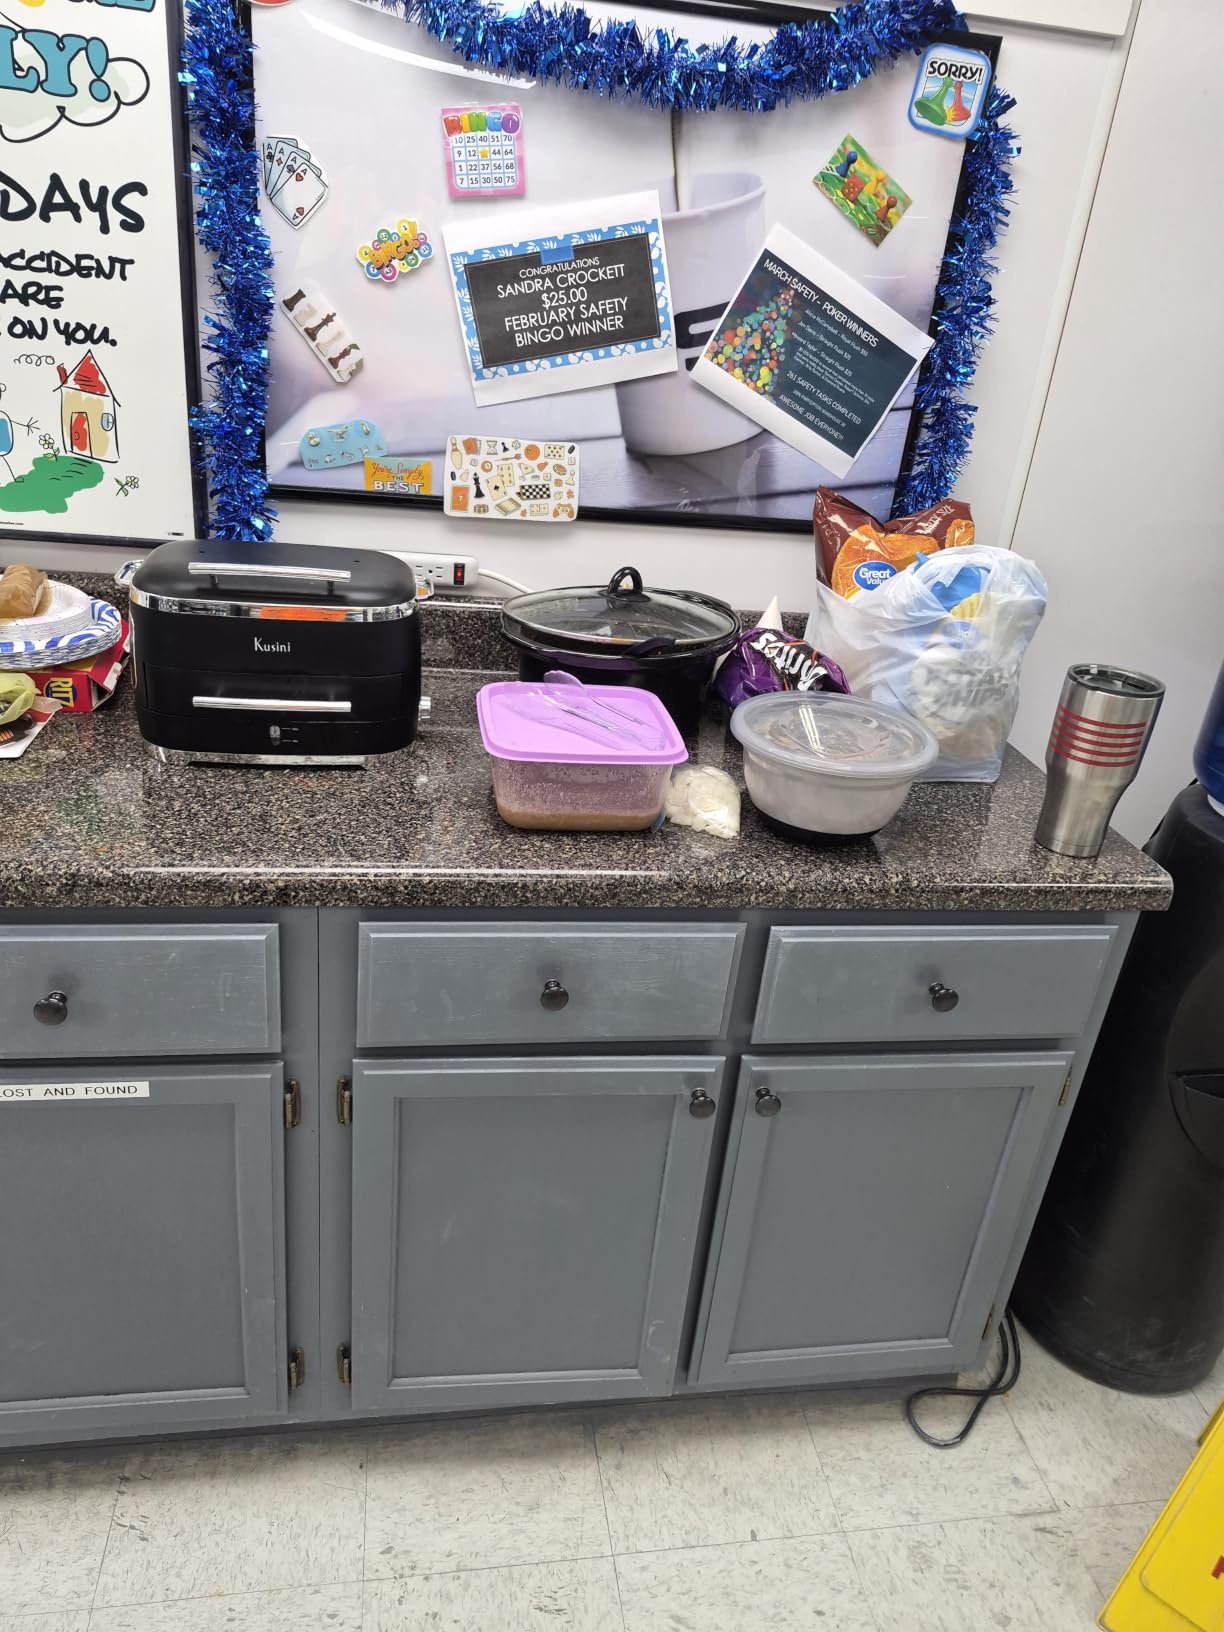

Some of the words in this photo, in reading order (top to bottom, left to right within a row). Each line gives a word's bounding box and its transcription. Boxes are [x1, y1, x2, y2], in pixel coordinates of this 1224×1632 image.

[928, 61, 983, 82] SORRY!
[443, 112, 520, 137] BINGO
[279, 147, 284, 155] A
[455, 136, 463, 144] 10
[291, 156, 297, 164] A
[457, 150, 462, 158] 9
[504, 148, 513, 156] 64
[300, 168, 307, 176] A
[505, 162, 514, 170] 68
[0, 170, 148, 235] DAYS
[369, 221, 420, 269] BINGO!
[519, 257, 600, 278] CONGRATULATIONS
[497, 278, 553, 298] SANDRA
[556, 264, 625, 288] CROCKETT
[542, 286, 588, 310] $25.00
[762, 258, 792, 285] MARCH
[788, 277, 819, 304] SAFETY
[821, 301, 848, 325] POKER
[844, 318, 879, 347] WINNERS
[504, 306, 576, 332] FEBRUARY
[580, 297, 628, 318] SAFETY
[7, 316, 48, 340] ON
[53, 318, 117, 347] YOU.
[515, 326, 564, 347] BINGO
[567, 316, 624, 337] WINNER
[786, 369, 797, 381] 261
[795, 376, 817, 394] SAFETY
[814, 389, 833, 405] TASKS
[830, 400, 861, 425] COMPLETED
[778, 393, 805, 415] AWESOME
[802, 410, 815, 422] JOB
[812, 417, 844, 442] EVERYONE!!!
[374, 480, 424, 493] BEST
[860, 568, 891, 578] Great
[254, 636, 290, 652] Kusini
[50, 678, 74, 707] RITZ
[0, 1088, 32, 1098] OST
[43, 1087, 76, 1096] AND
[85, 1085, 138, 1095] FOUND
